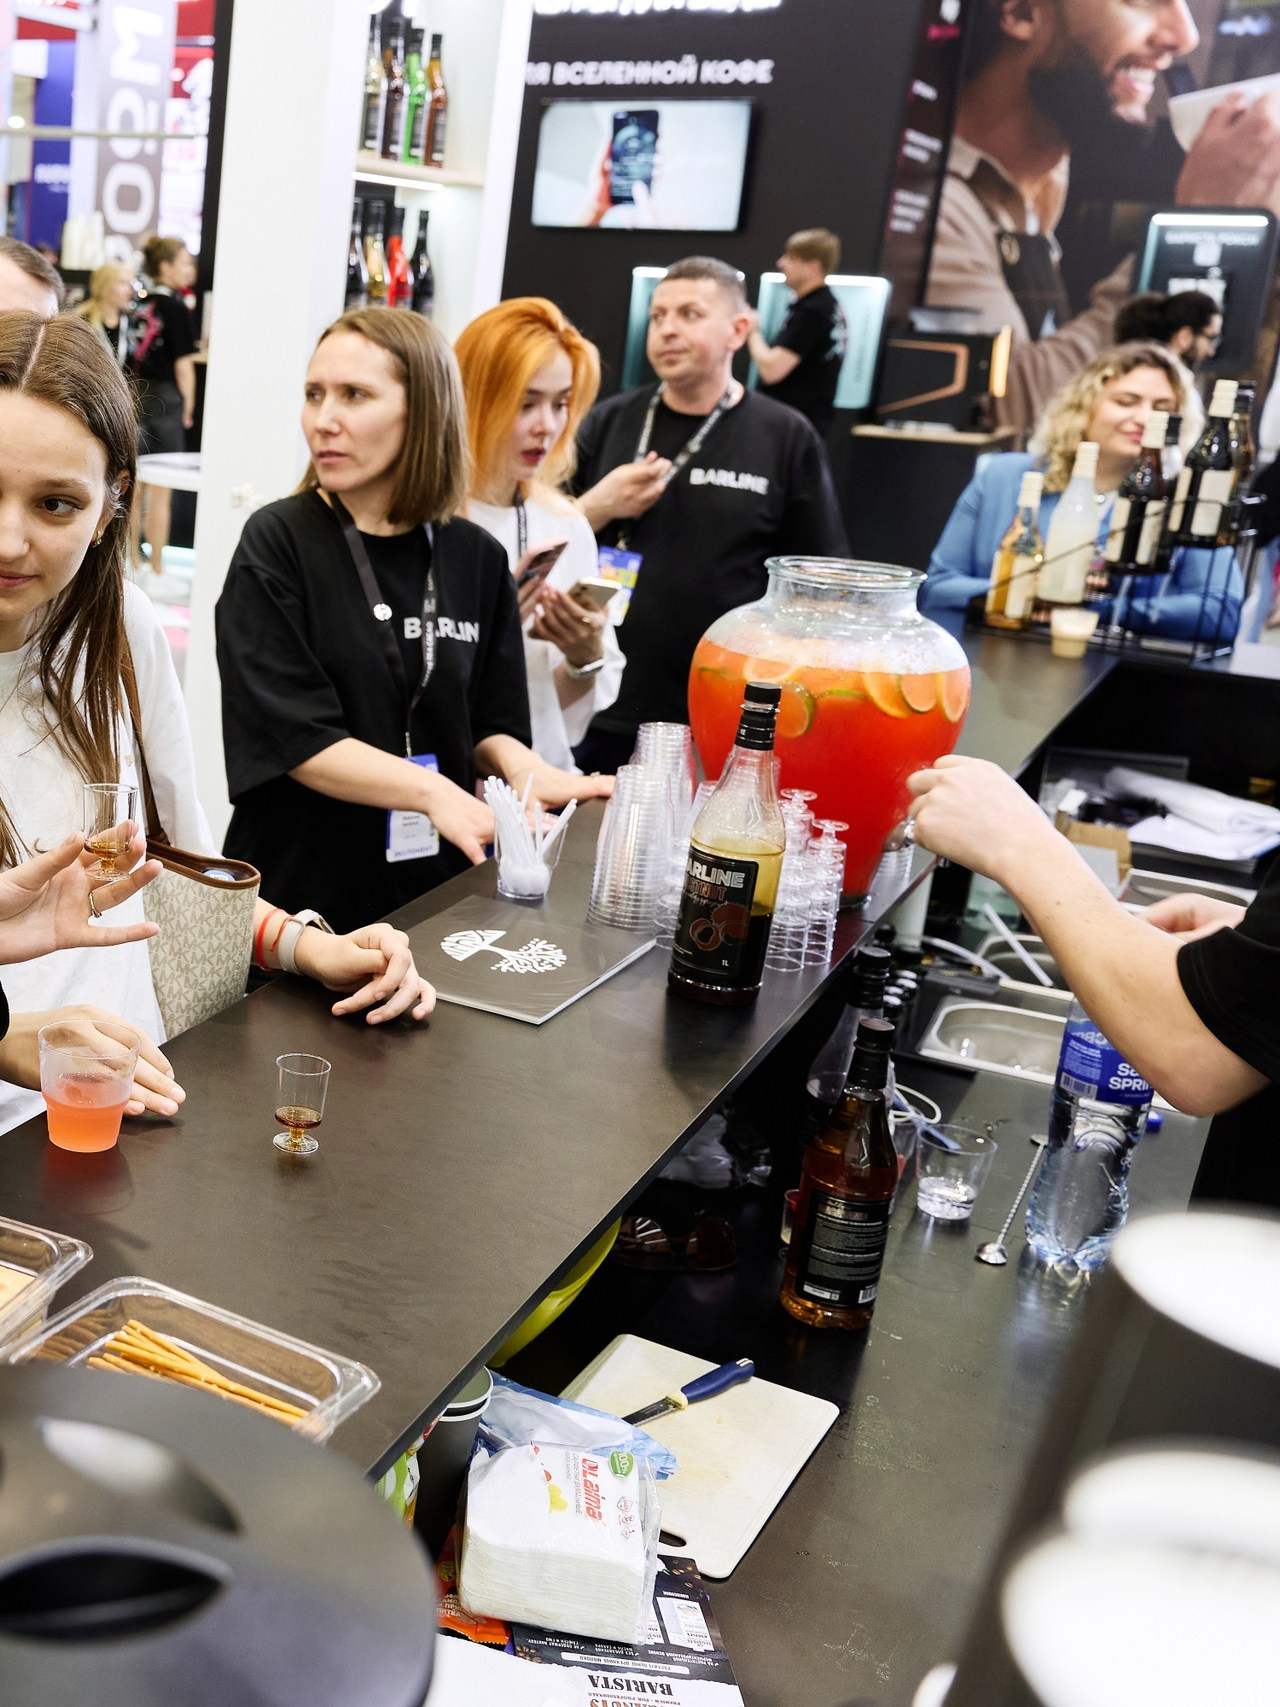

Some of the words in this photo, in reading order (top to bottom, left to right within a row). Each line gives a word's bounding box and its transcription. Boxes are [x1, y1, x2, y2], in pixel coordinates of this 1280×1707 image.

[552, 54, 698, 85] ВСЕЛЕННОЙ
[700, 59, 774, 84] КОФЕ
[689, 467, 769, 495] BARLINE
[685, 858, 746, 889] ARLINE
[587, 1674, 674, 1697] BARISTA
